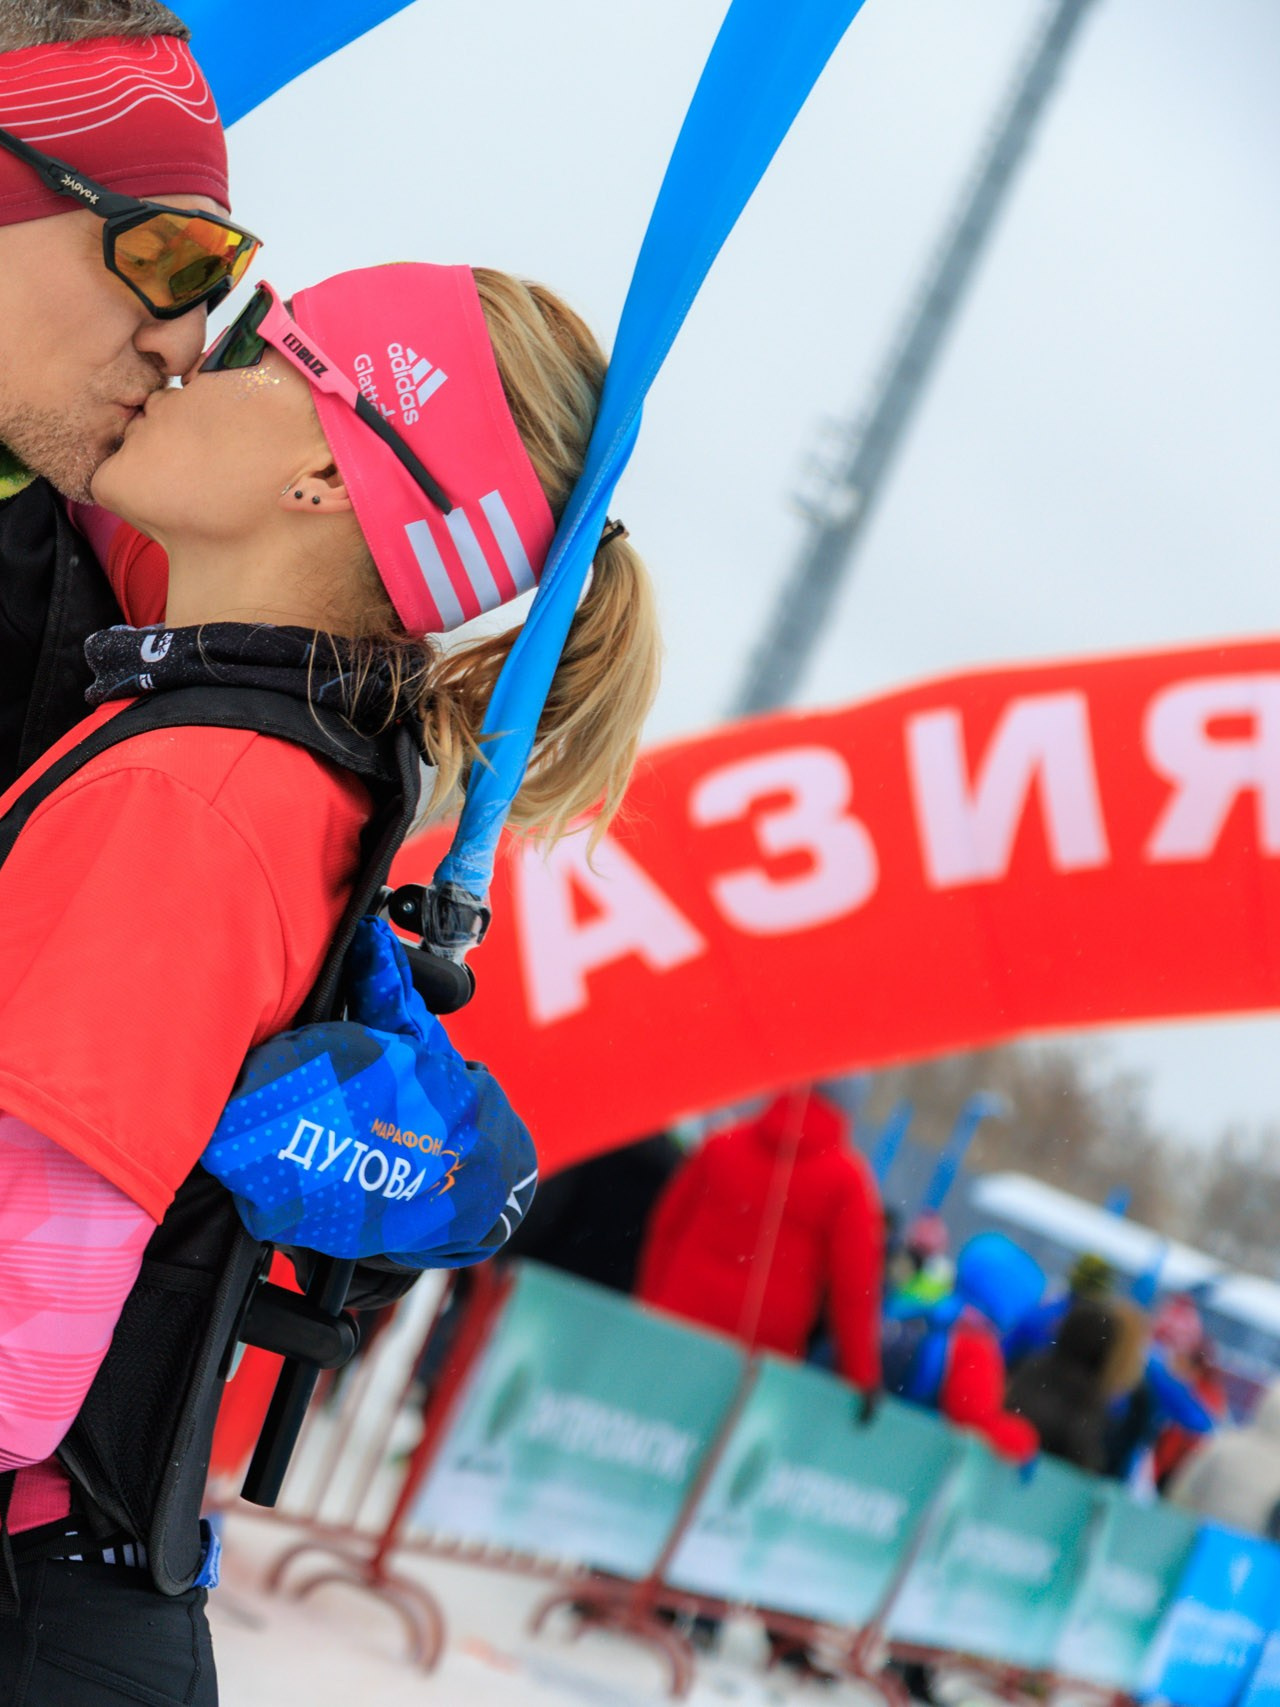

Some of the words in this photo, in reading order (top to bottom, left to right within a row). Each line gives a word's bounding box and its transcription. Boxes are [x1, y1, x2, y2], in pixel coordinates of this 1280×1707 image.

[387, 343, 419, 425] adidas
[519, 671, 1280, 1029] АЗИЯ
[278, 1118, 428, 1202] ДУТОВА
[371, 1118, 443, 1156] МАРАФОН
